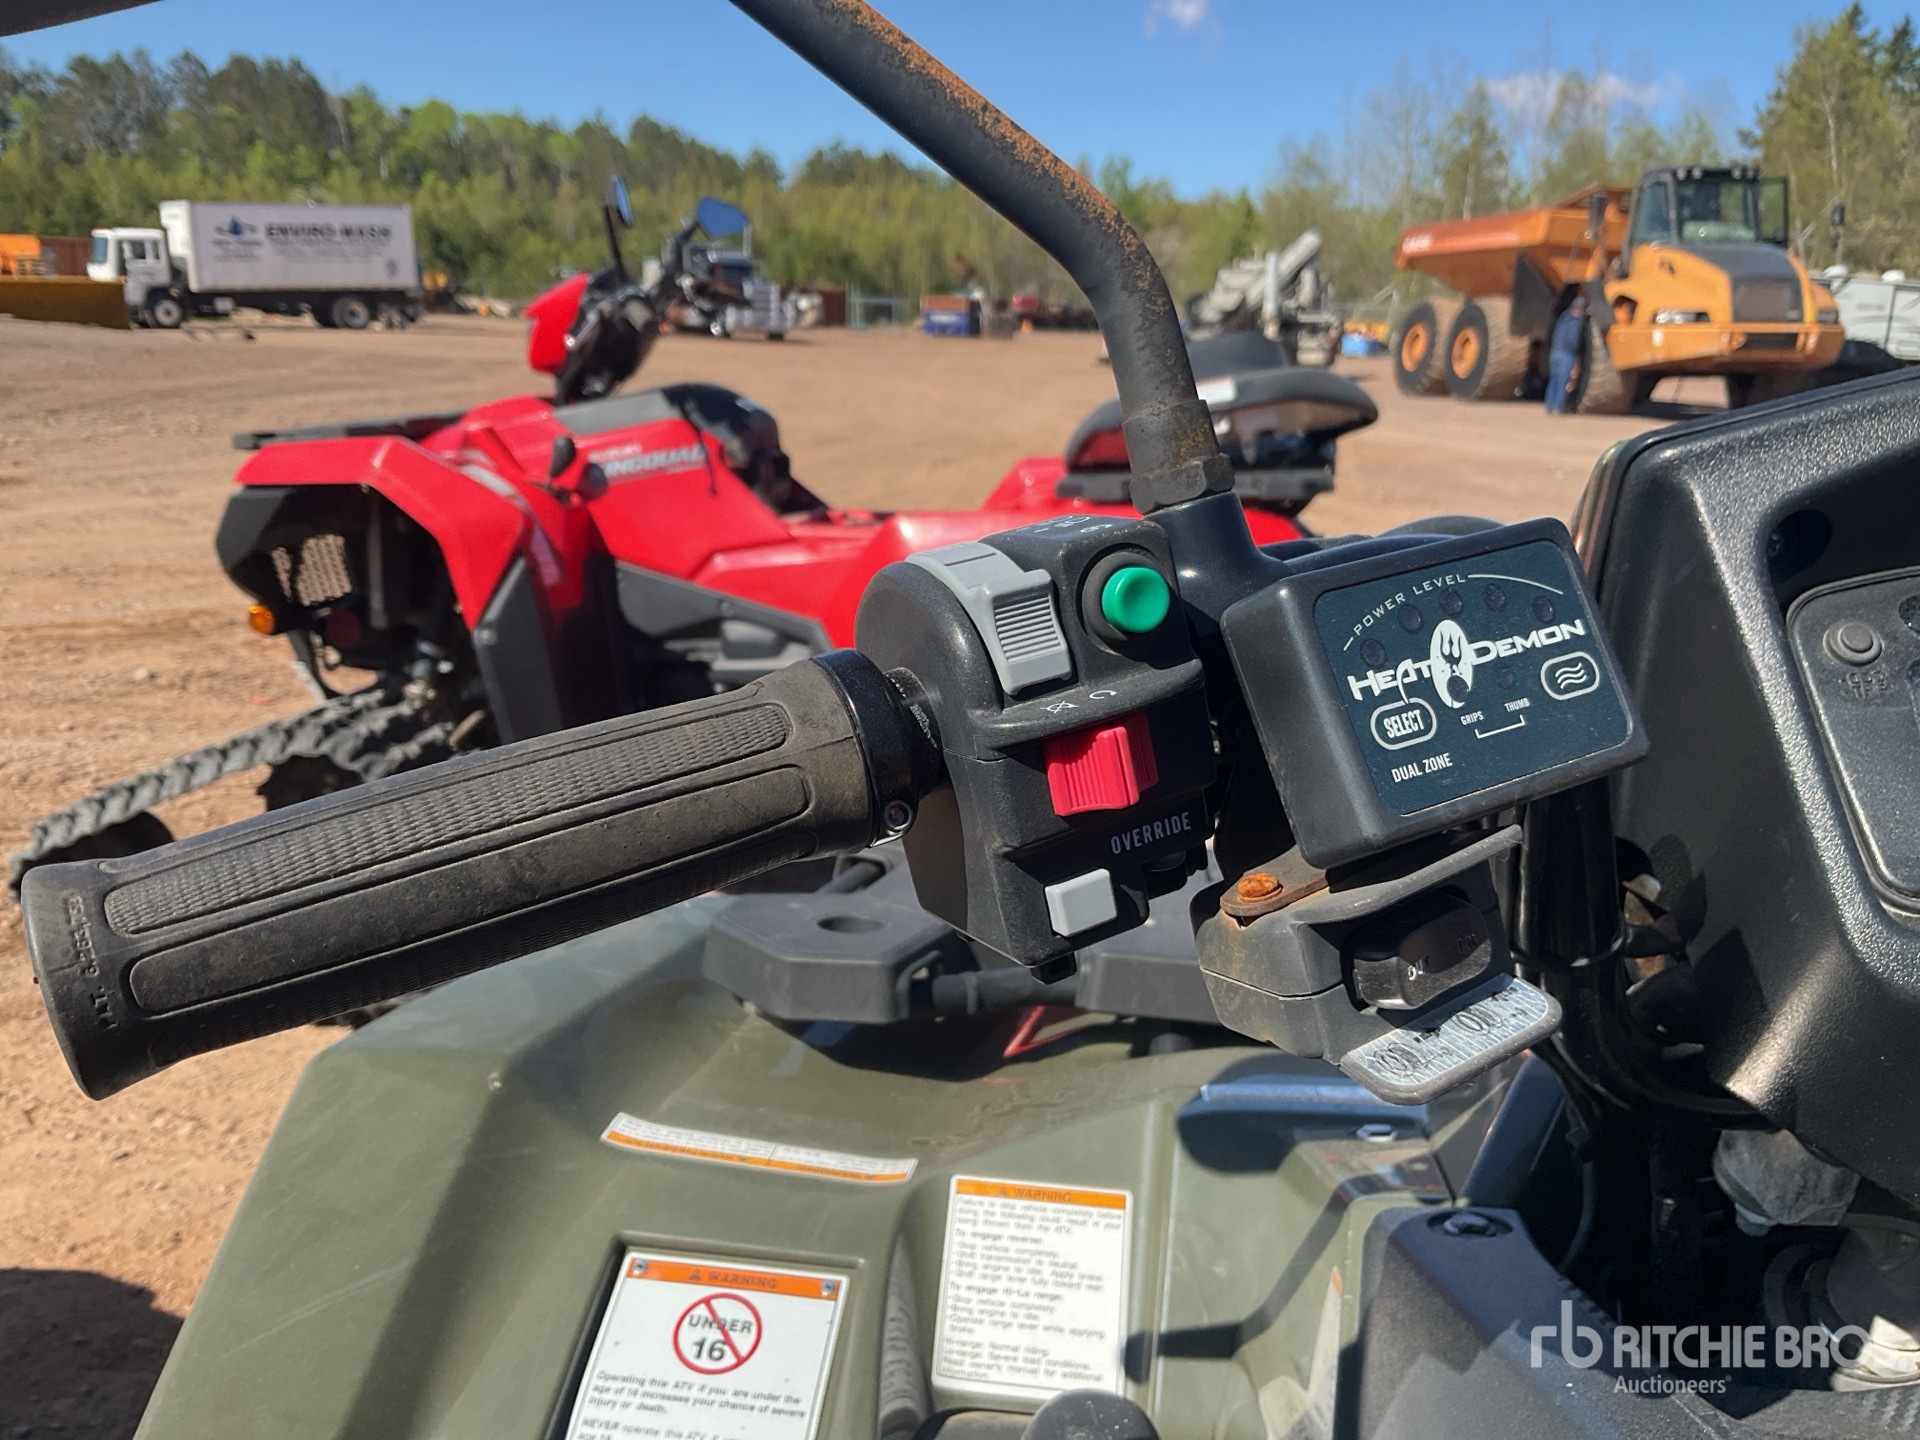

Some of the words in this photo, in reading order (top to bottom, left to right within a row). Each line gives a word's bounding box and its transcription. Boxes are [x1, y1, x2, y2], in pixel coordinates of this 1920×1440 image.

[1353, 592, 1406, 636] POWER
[1412, 573, 1466, 595] LEVEL
[1347, 659, 1431, 704] HEAT
[1467, 619, 1586, 668] DEMON
[1504, 697, 1530, 713] THUMB
[1383, 709, 1425, 739] SELECT
[1460, 711, 1484, 726] GRIPS
[1391, 763, 1423, 783] DUAL
[1422, 752, 1453, 773] ZONE
[1110, 811, 1192, 855] OVERRIDE
[1014, 1187, 1074, 1203] WARNING
[708, 1271, 777, 1288] WARNING
[689, 1314, 754, 1334] UNDER
[693, 1337, 727, 1362] 16
